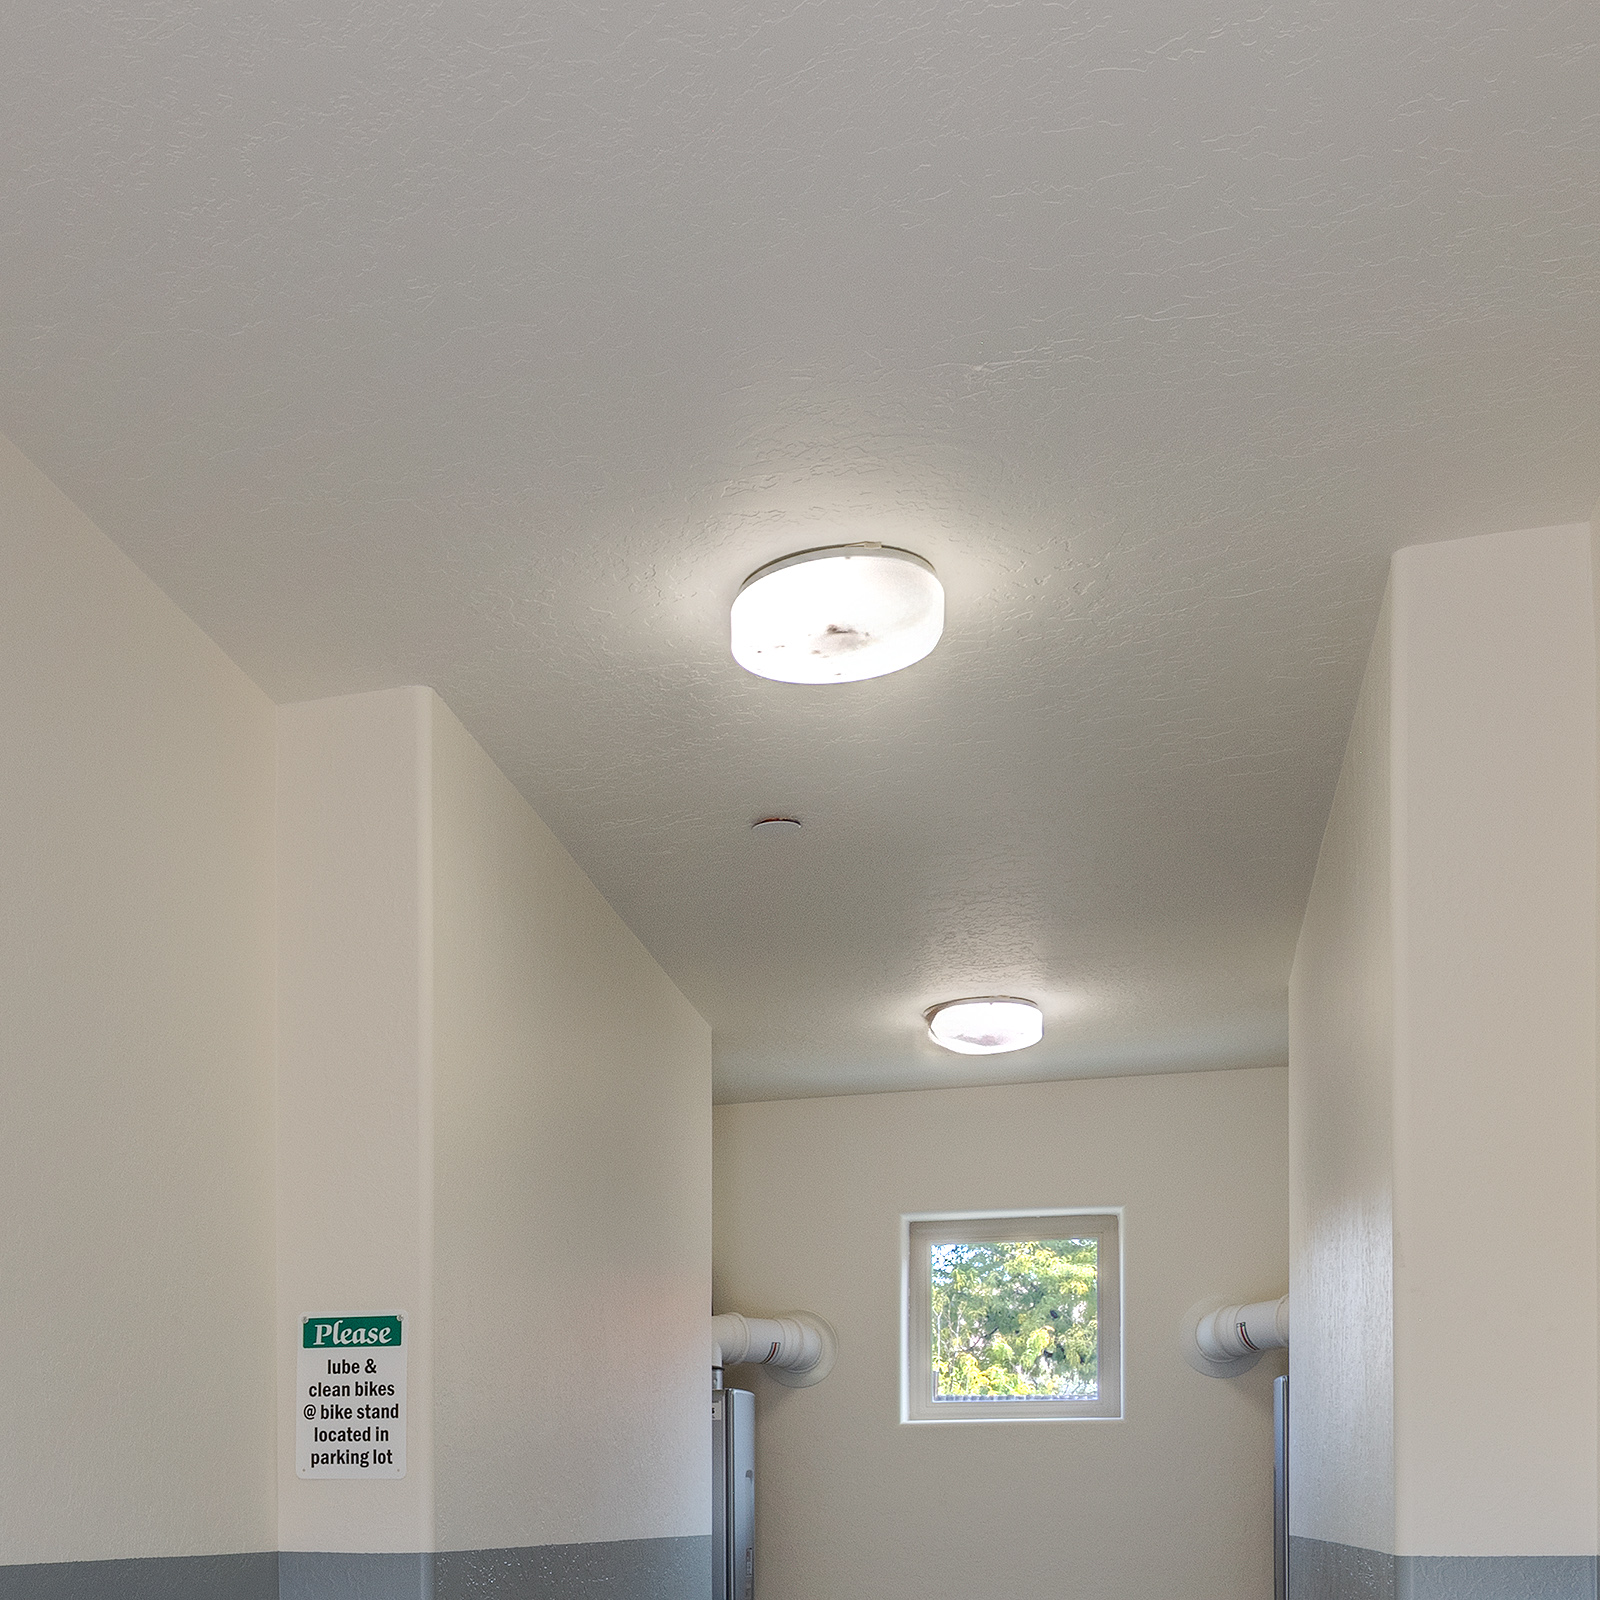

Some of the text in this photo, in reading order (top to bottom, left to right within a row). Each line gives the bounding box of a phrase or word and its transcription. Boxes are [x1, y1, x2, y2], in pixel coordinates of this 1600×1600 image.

[312, 1320, 392, 1346] Please
[327, 1358, 377, 1374] lube &
[308, 1381, 395, 1397] clean bikes
[303, 1403, 399, 1420] @ bike stand
[314, 1426, 389, 1442] located in
[311, 1449, 393, 1468] parking lot
